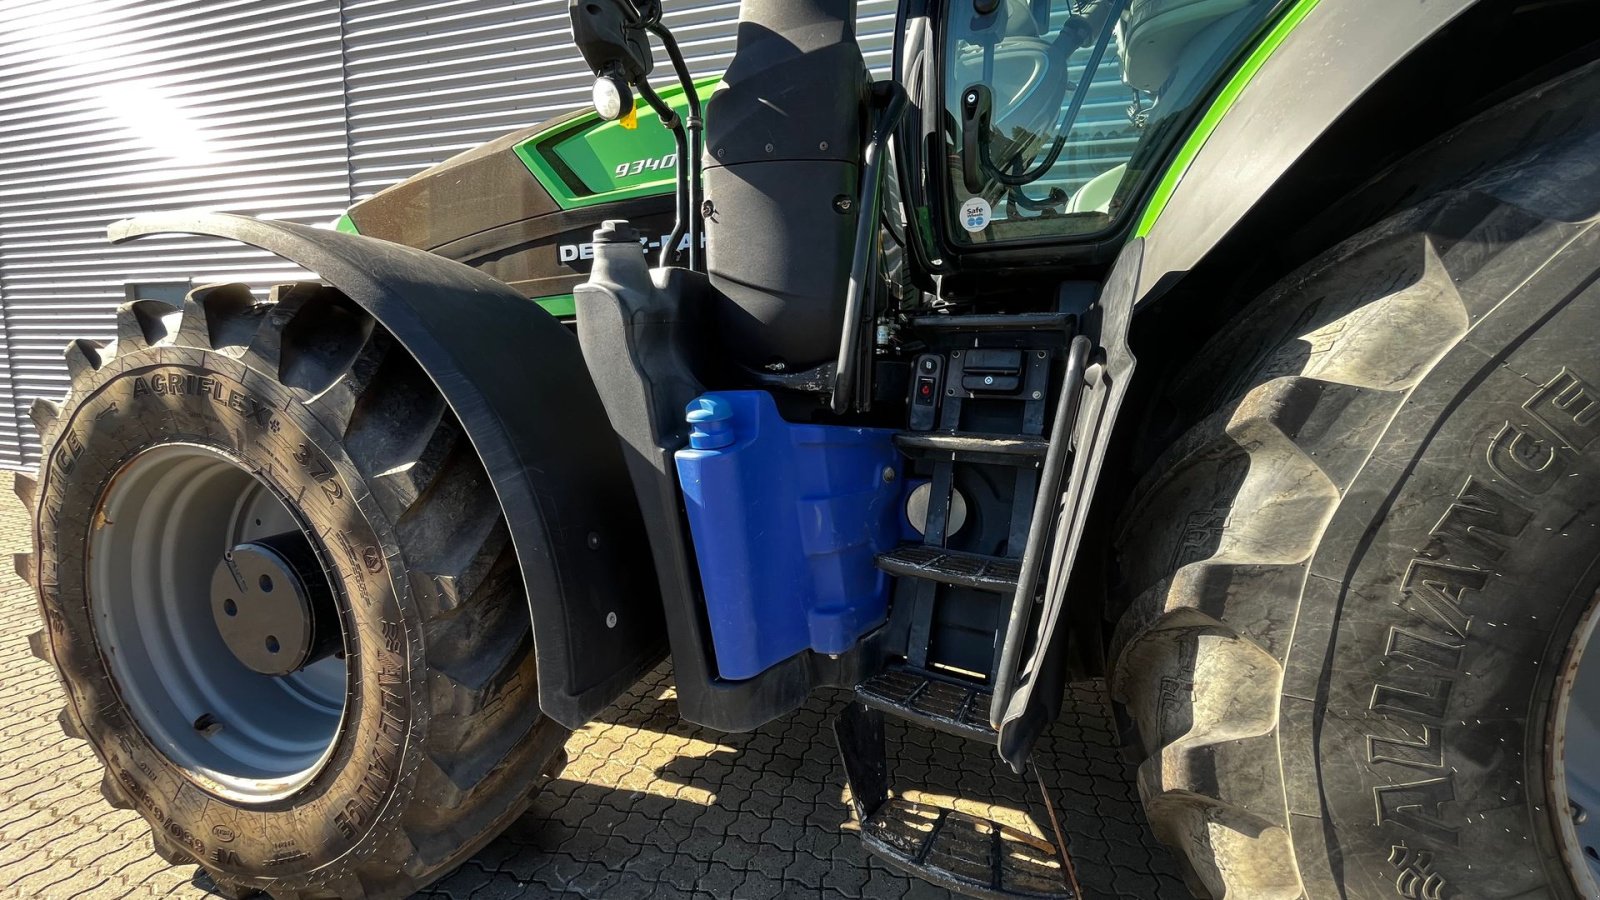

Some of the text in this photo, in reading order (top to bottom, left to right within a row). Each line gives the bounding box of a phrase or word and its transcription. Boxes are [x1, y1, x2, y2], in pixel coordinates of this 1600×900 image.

[615, 153, 677, 178] 9340
[967, 206, 983, 214] Safe
[293, 442, 343, 505] 372
[1367, 366, 1600, 847] ALLIANCE
[334, 650, 403, 839] ALLIANCE
